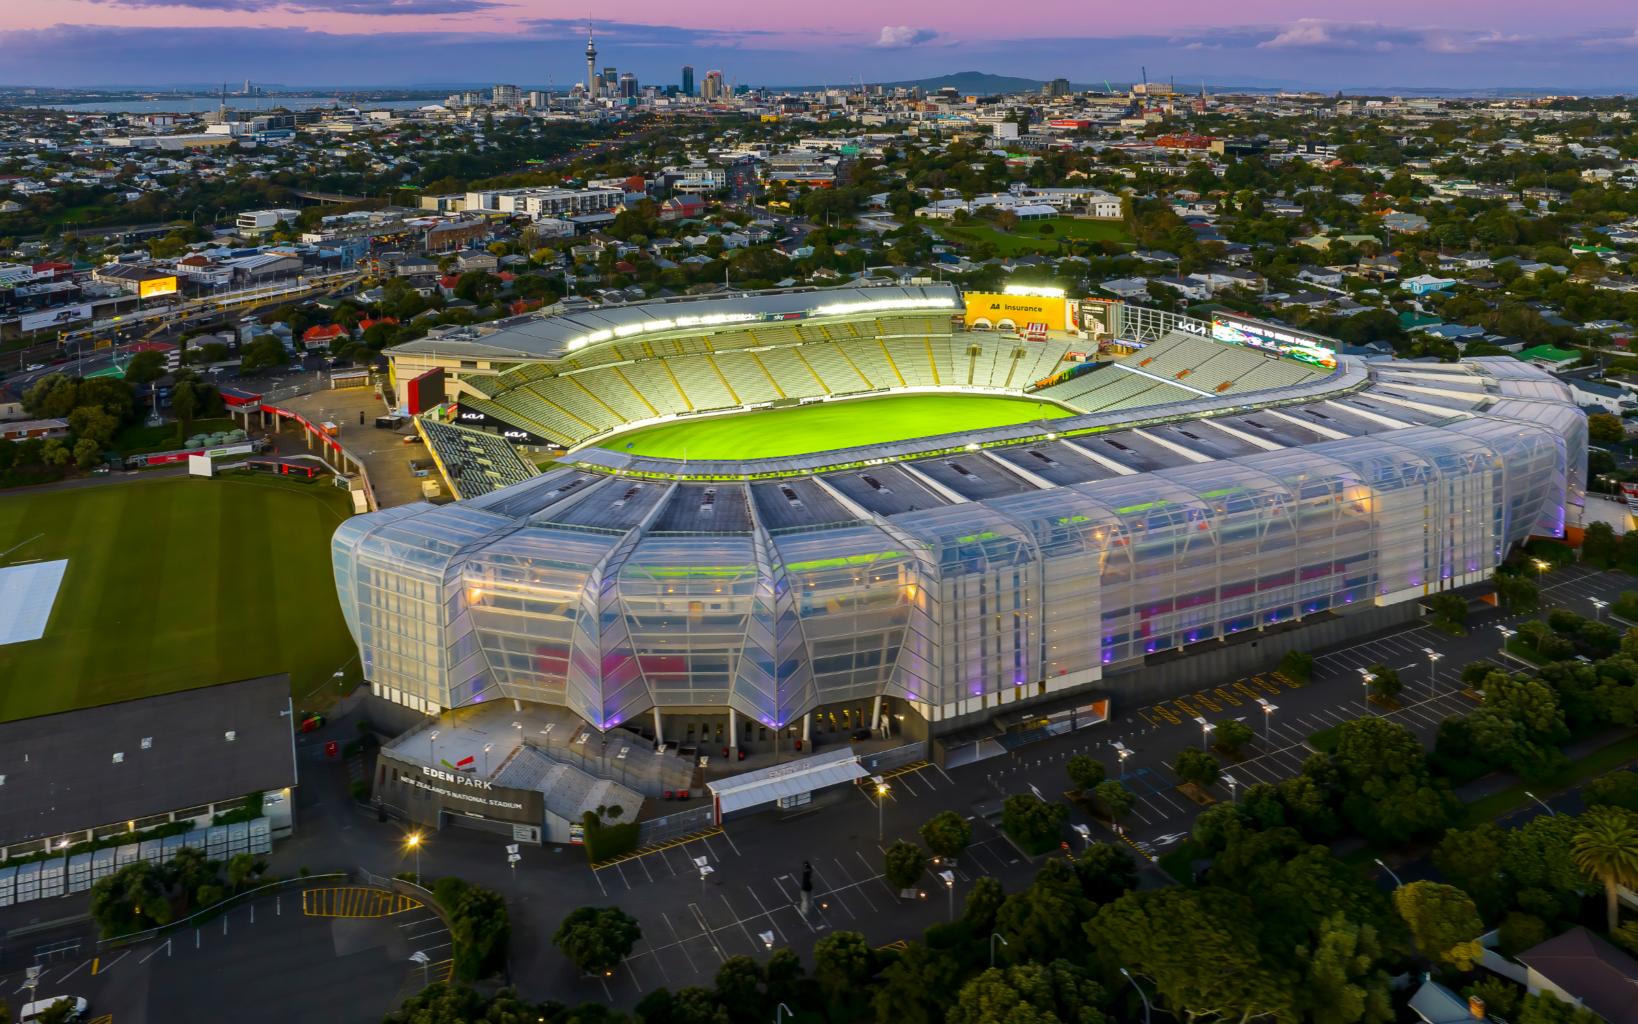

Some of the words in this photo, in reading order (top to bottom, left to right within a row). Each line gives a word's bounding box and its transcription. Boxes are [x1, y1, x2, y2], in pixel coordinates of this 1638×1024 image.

[1004, 303, 1042, 312] Insurance
[1178, 321, 1206, 335] KIA
[1228, 321, 1264, 336] WELCOME
[1263, 329, 1275, 338] TO
[422, 766, 455, 783] EDEN
[456, 775, 493, 791] PARK
[768, 764, 798, 779] ENTRY
[400, 775, 416, 785] NEW
[415, 780, 452, 797] ZEALAND'S
[451, 792, 489, 805] NATIONAL
[488, 799, 523, 810] STADIUM
